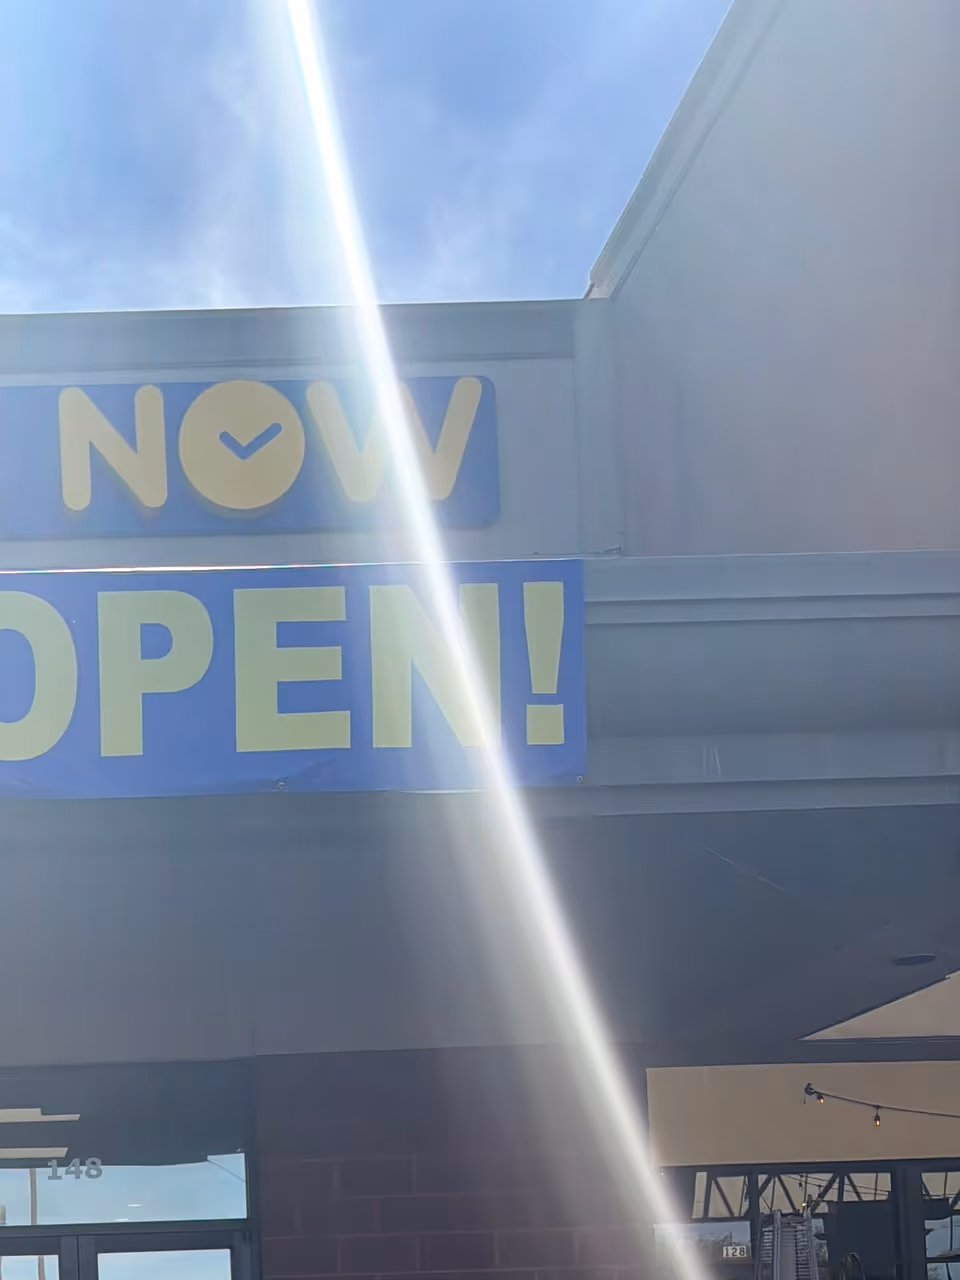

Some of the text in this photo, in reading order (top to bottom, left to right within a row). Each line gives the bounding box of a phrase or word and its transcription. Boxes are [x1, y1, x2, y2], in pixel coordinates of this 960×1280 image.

[59, 376, 483, 511] NOW
[47, 1157, 103, 1181] 148
[725, 1246, 745, 1257] 128
